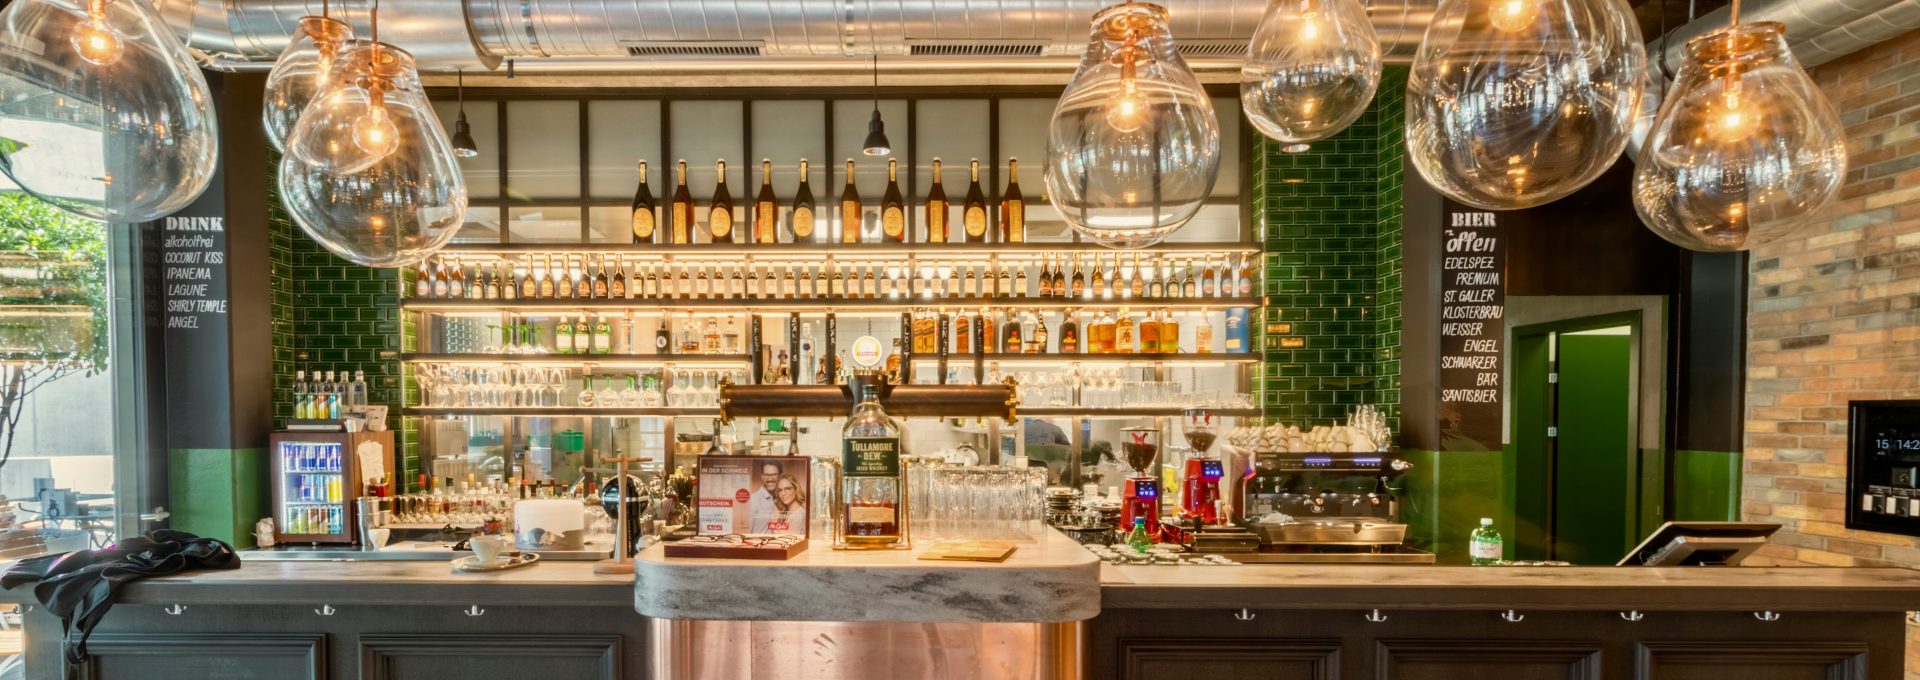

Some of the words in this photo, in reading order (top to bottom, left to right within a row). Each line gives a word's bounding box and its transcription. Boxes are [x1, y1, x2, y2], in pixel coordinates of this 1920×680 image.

[165, 216, 224, 231] DRINK
[1451, 212, 1496, 227] BIER
[164, 234, 214, 248] alkoholfrei
[165, 251, 201, 264] COCONUT
[205, 251, 223, 264] KISS
[1444, 256, 1494, 269] EDELSPEZ
[167, 267, 211, 280] IPANEMA
[1456, 272, 1499, 285] PREMIUM
[168, 284, 208, 297] LAGUNE
[1444, 290, 1456, 302] ST.
[1459, 289, 1495, 302] GALLER
[168, 299, 195, 312] SHIRLY
[197, 299, 227, 313] TEMPLE
[1442, 305, 1503, 319] KLOSTERBRÄU
[168, 316, 199, 328] ANGEL
[1442, 322, 1483, 336] WEISSER
[1463, 339, 1498, 352] ENGEL
[1441, 355, 1497, 369] SCHWARZER
[1476, 372, 1498, 386] BÄR
[1441, 389, 1497, 403] SÄNTISBIER
[850, 440, 894, 452] TULLAMORE
[1875, 438, 1889, 449] 15
[1896, 439, 1920, 450] 14:2
[863, 451, 881, 461] DEW
